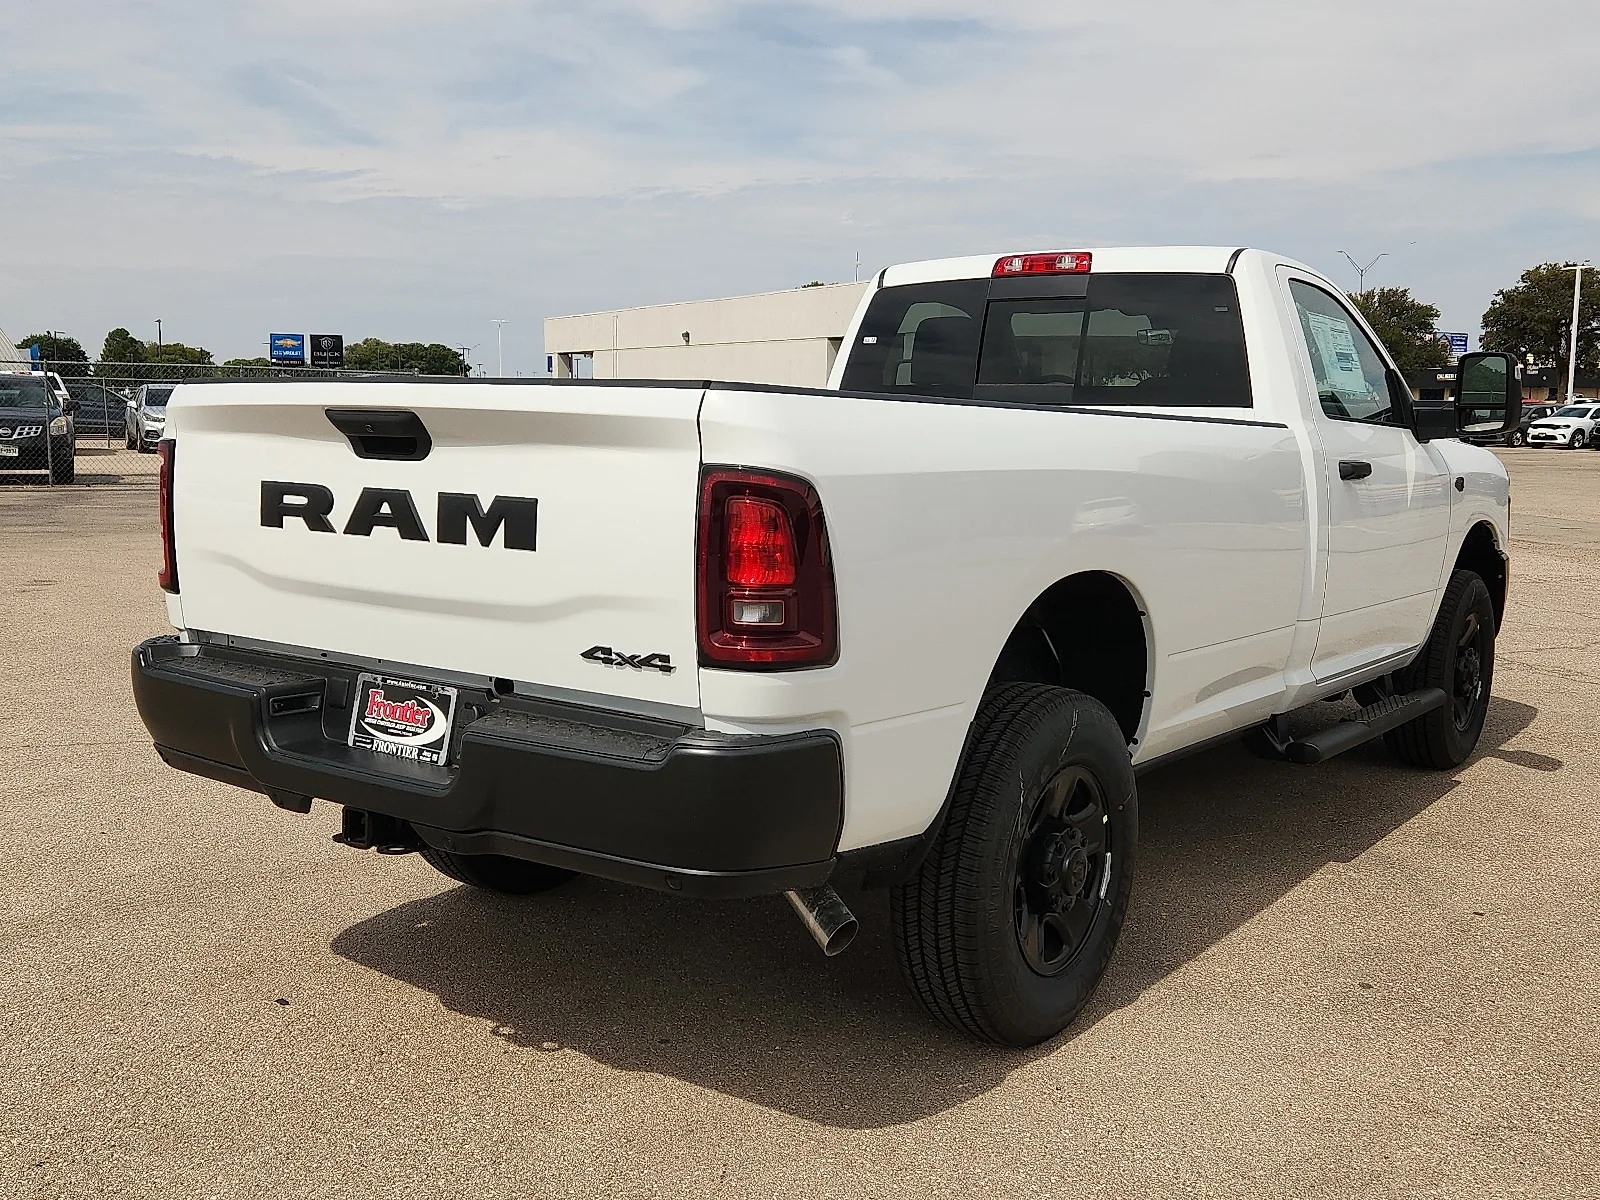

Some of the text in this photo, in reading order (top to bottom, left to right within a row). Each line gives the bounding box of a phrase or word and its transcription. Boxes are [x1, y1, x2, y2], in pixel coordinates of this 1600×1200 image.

[260, 480, 538, 552] RAM
[365, 688, 431, 728] Frontier
[372, 739, 419, 760] FRONTIER
